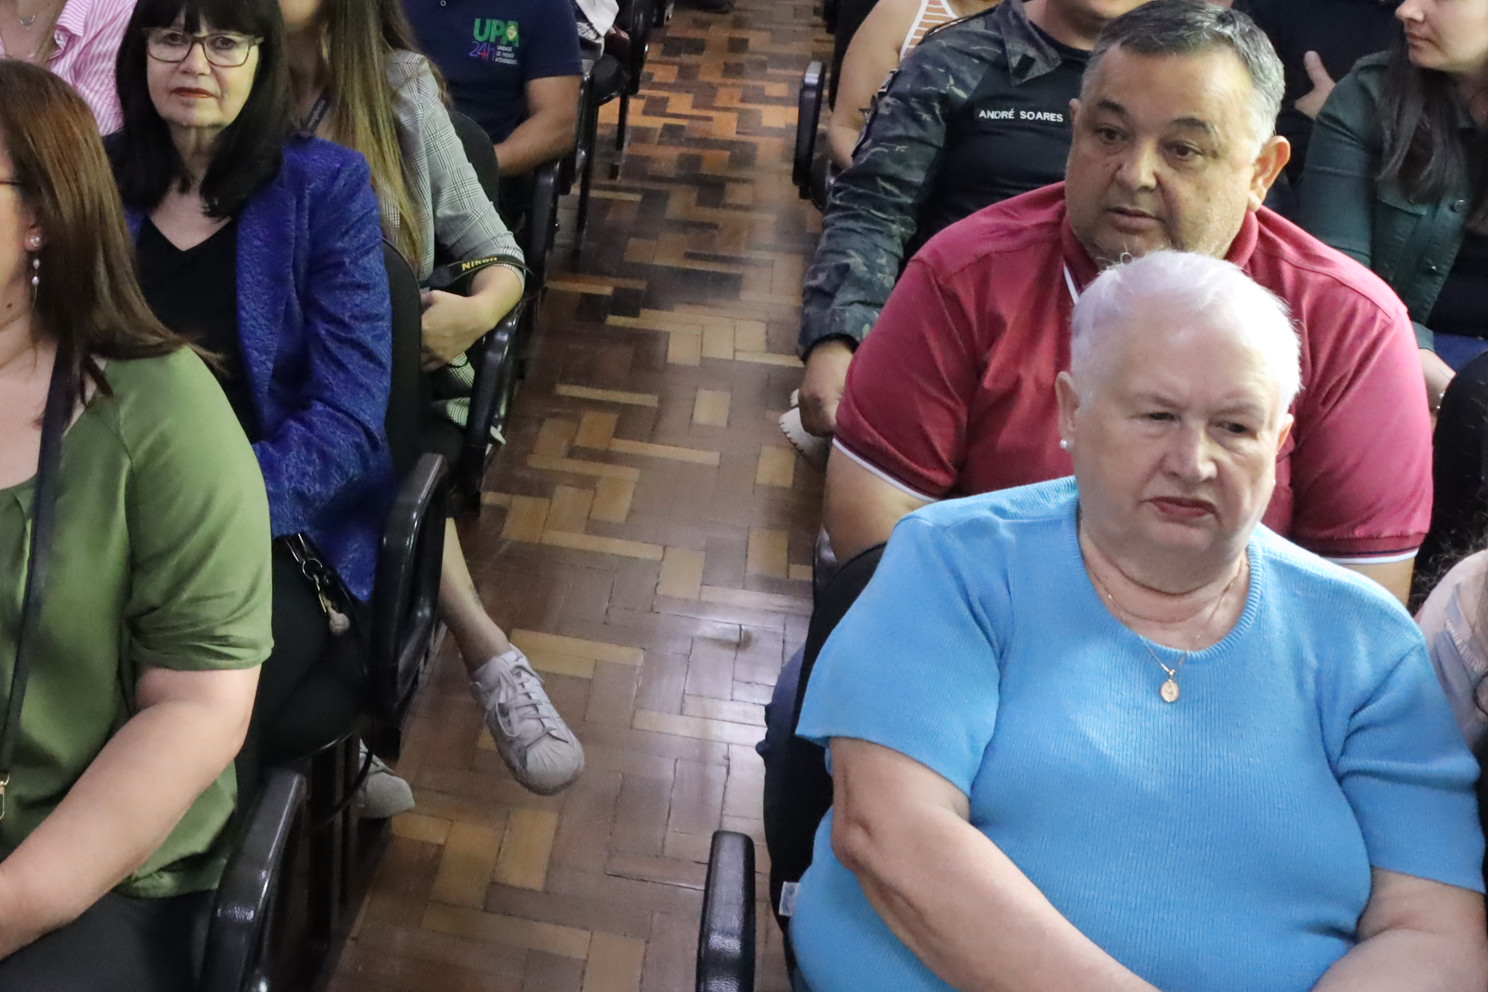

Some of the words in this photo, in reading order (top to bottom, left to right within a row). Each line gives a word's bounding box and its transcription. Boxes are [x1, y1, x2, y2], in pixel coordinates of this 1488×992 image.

[473, 18, 520, 48] UPA
[979, 108, 1014, 119] ANDRÉ
[1020, 111, 1063, 122] SOARES
